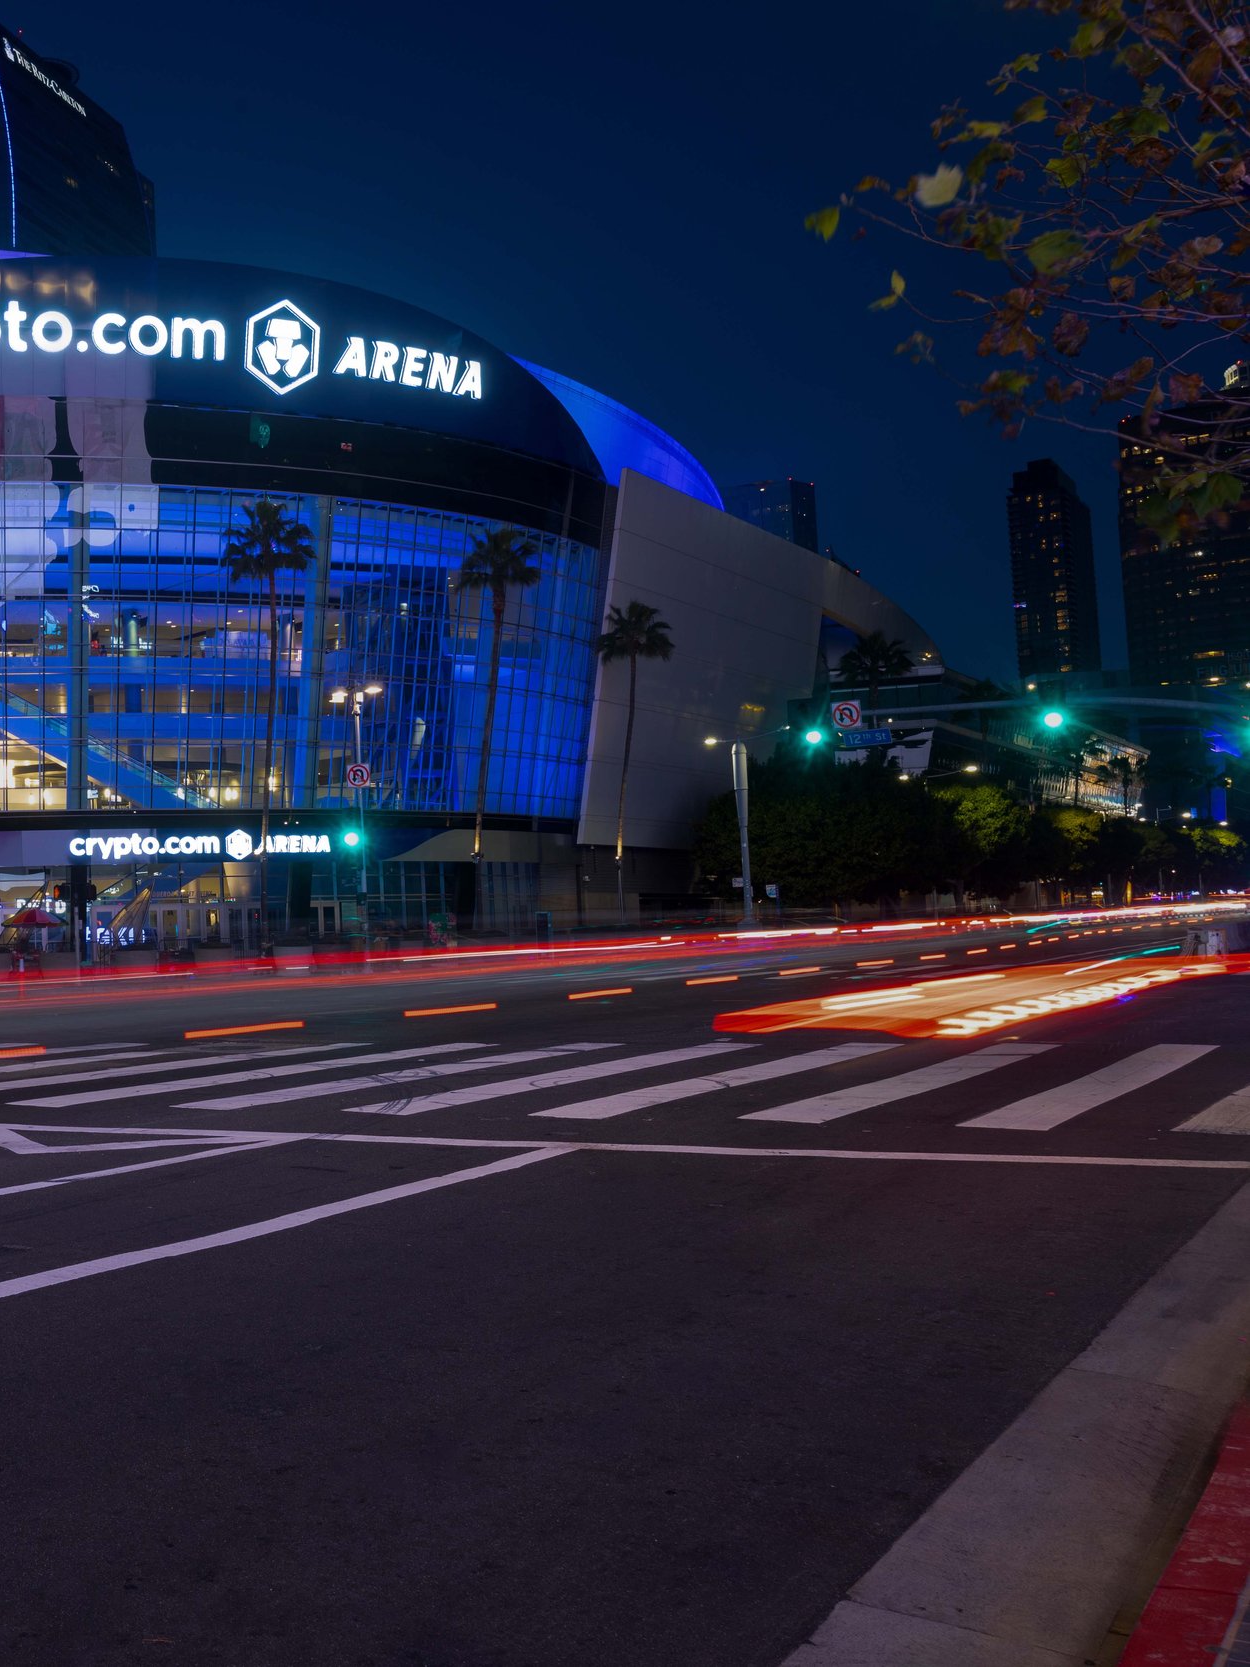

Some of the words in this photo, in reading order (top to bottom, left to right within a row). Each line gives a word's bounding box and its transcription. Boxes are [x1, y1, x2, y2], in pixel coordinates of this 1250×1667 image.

[333, 335, 483, 400] ARENA
[875, 732, 886, 741] St
[69, 833, 220, 860] crypto.com
[253, 834, 331, 855] ARENA
